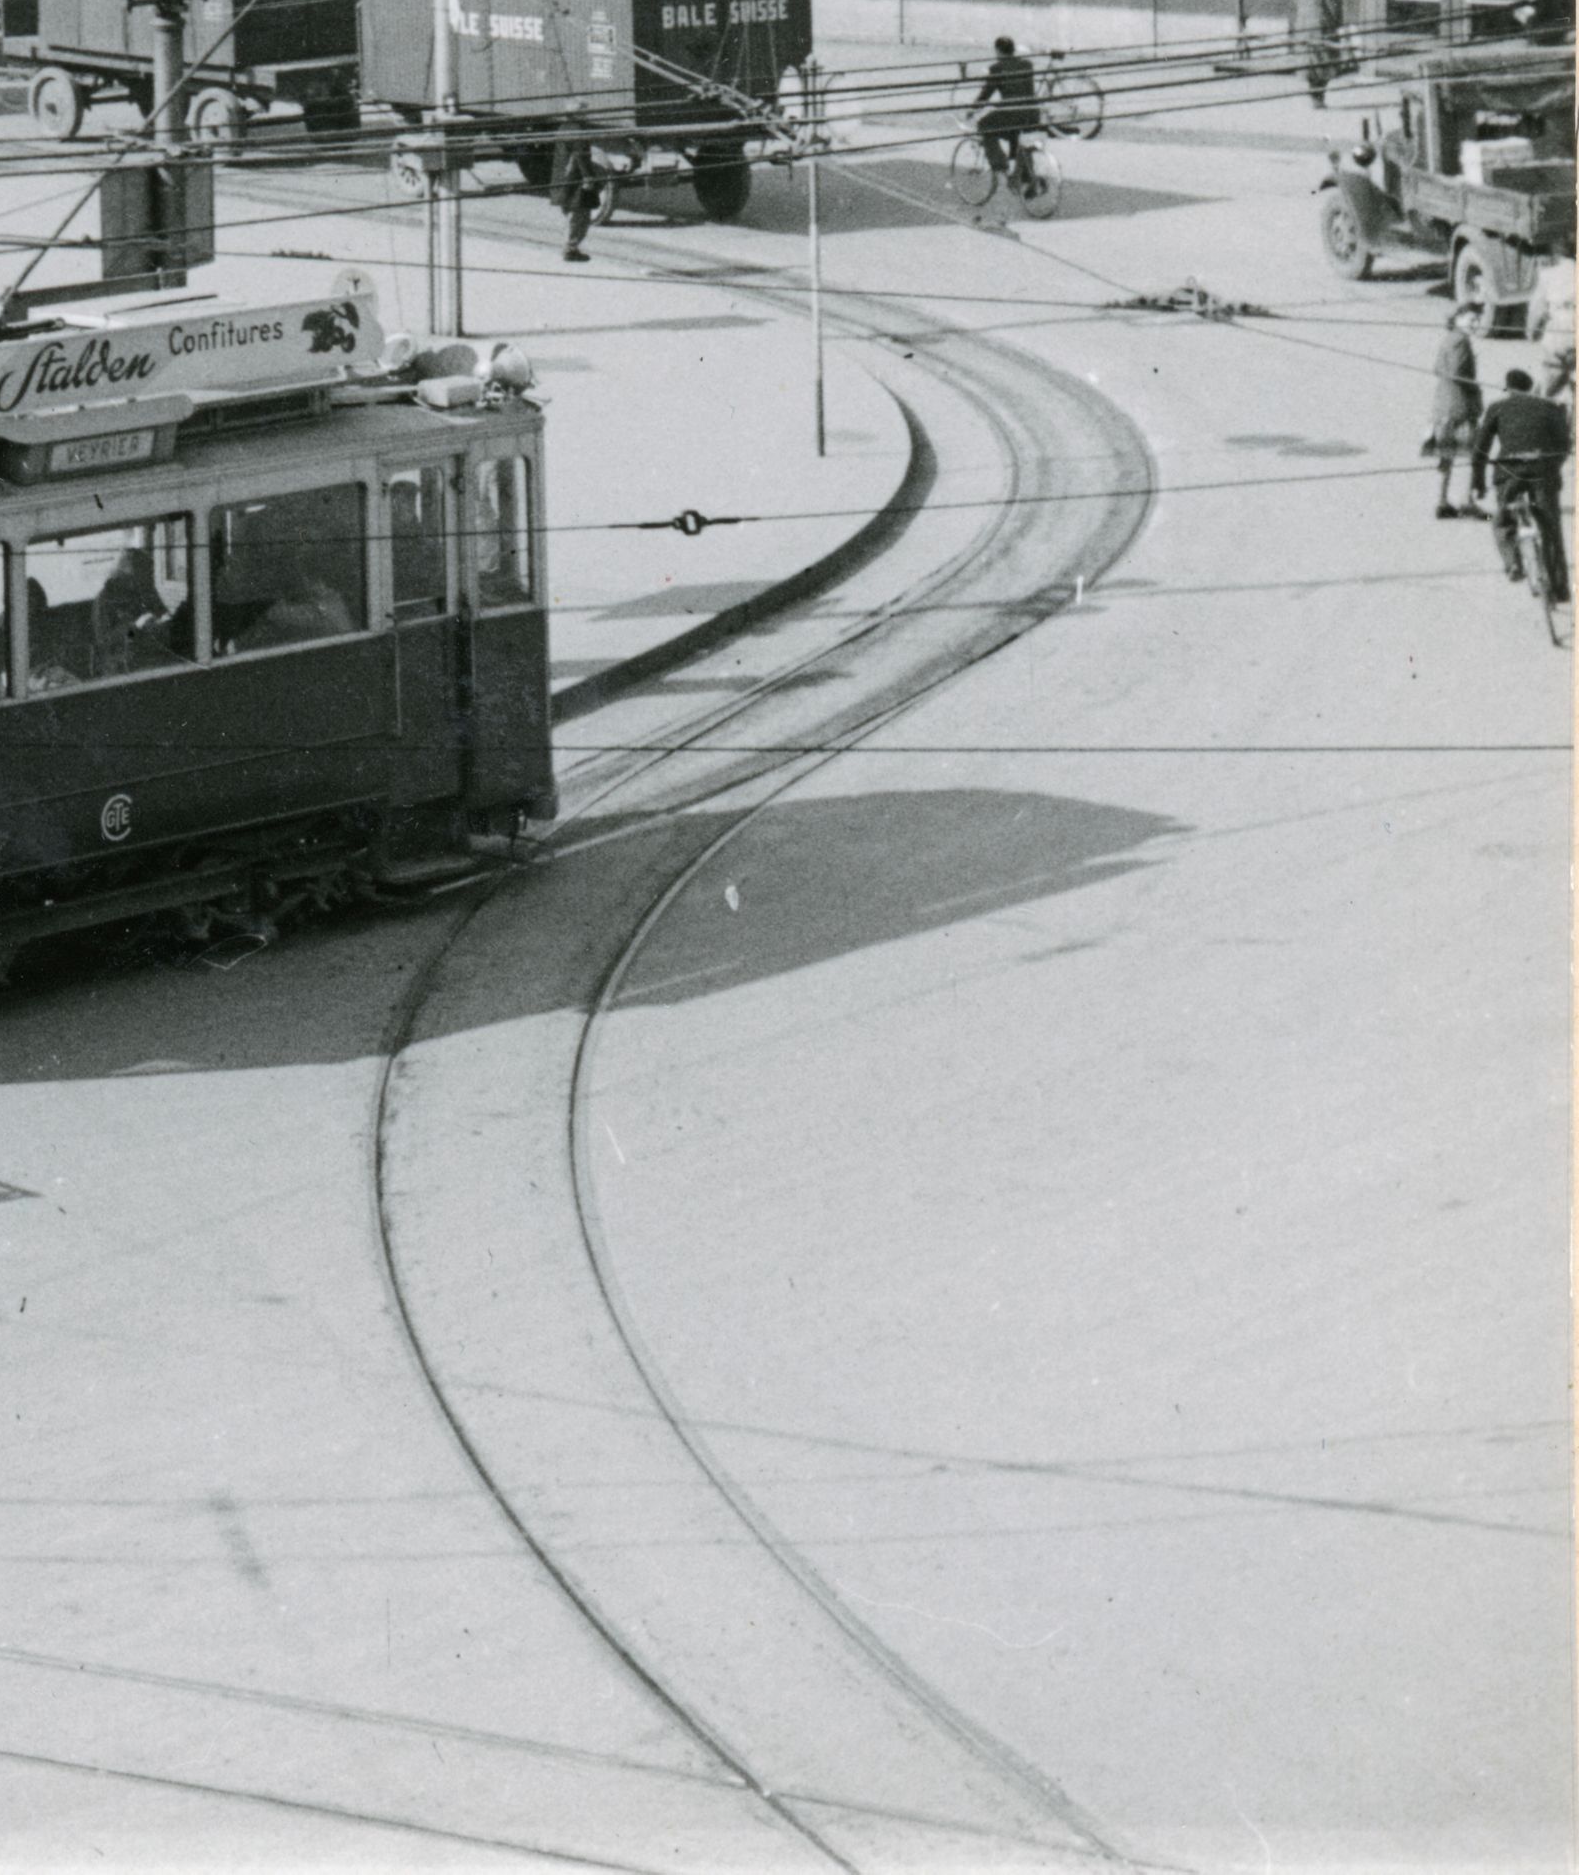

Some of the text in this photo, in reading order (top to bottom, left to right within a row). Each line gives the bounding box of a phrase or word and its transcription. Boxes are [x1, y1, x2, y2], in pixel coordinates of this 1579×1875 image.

[662, 3, 717, 29] BALE
[167, 318, 284, 357] Confitures
[65, 434, 143, 465] VEYRIER
